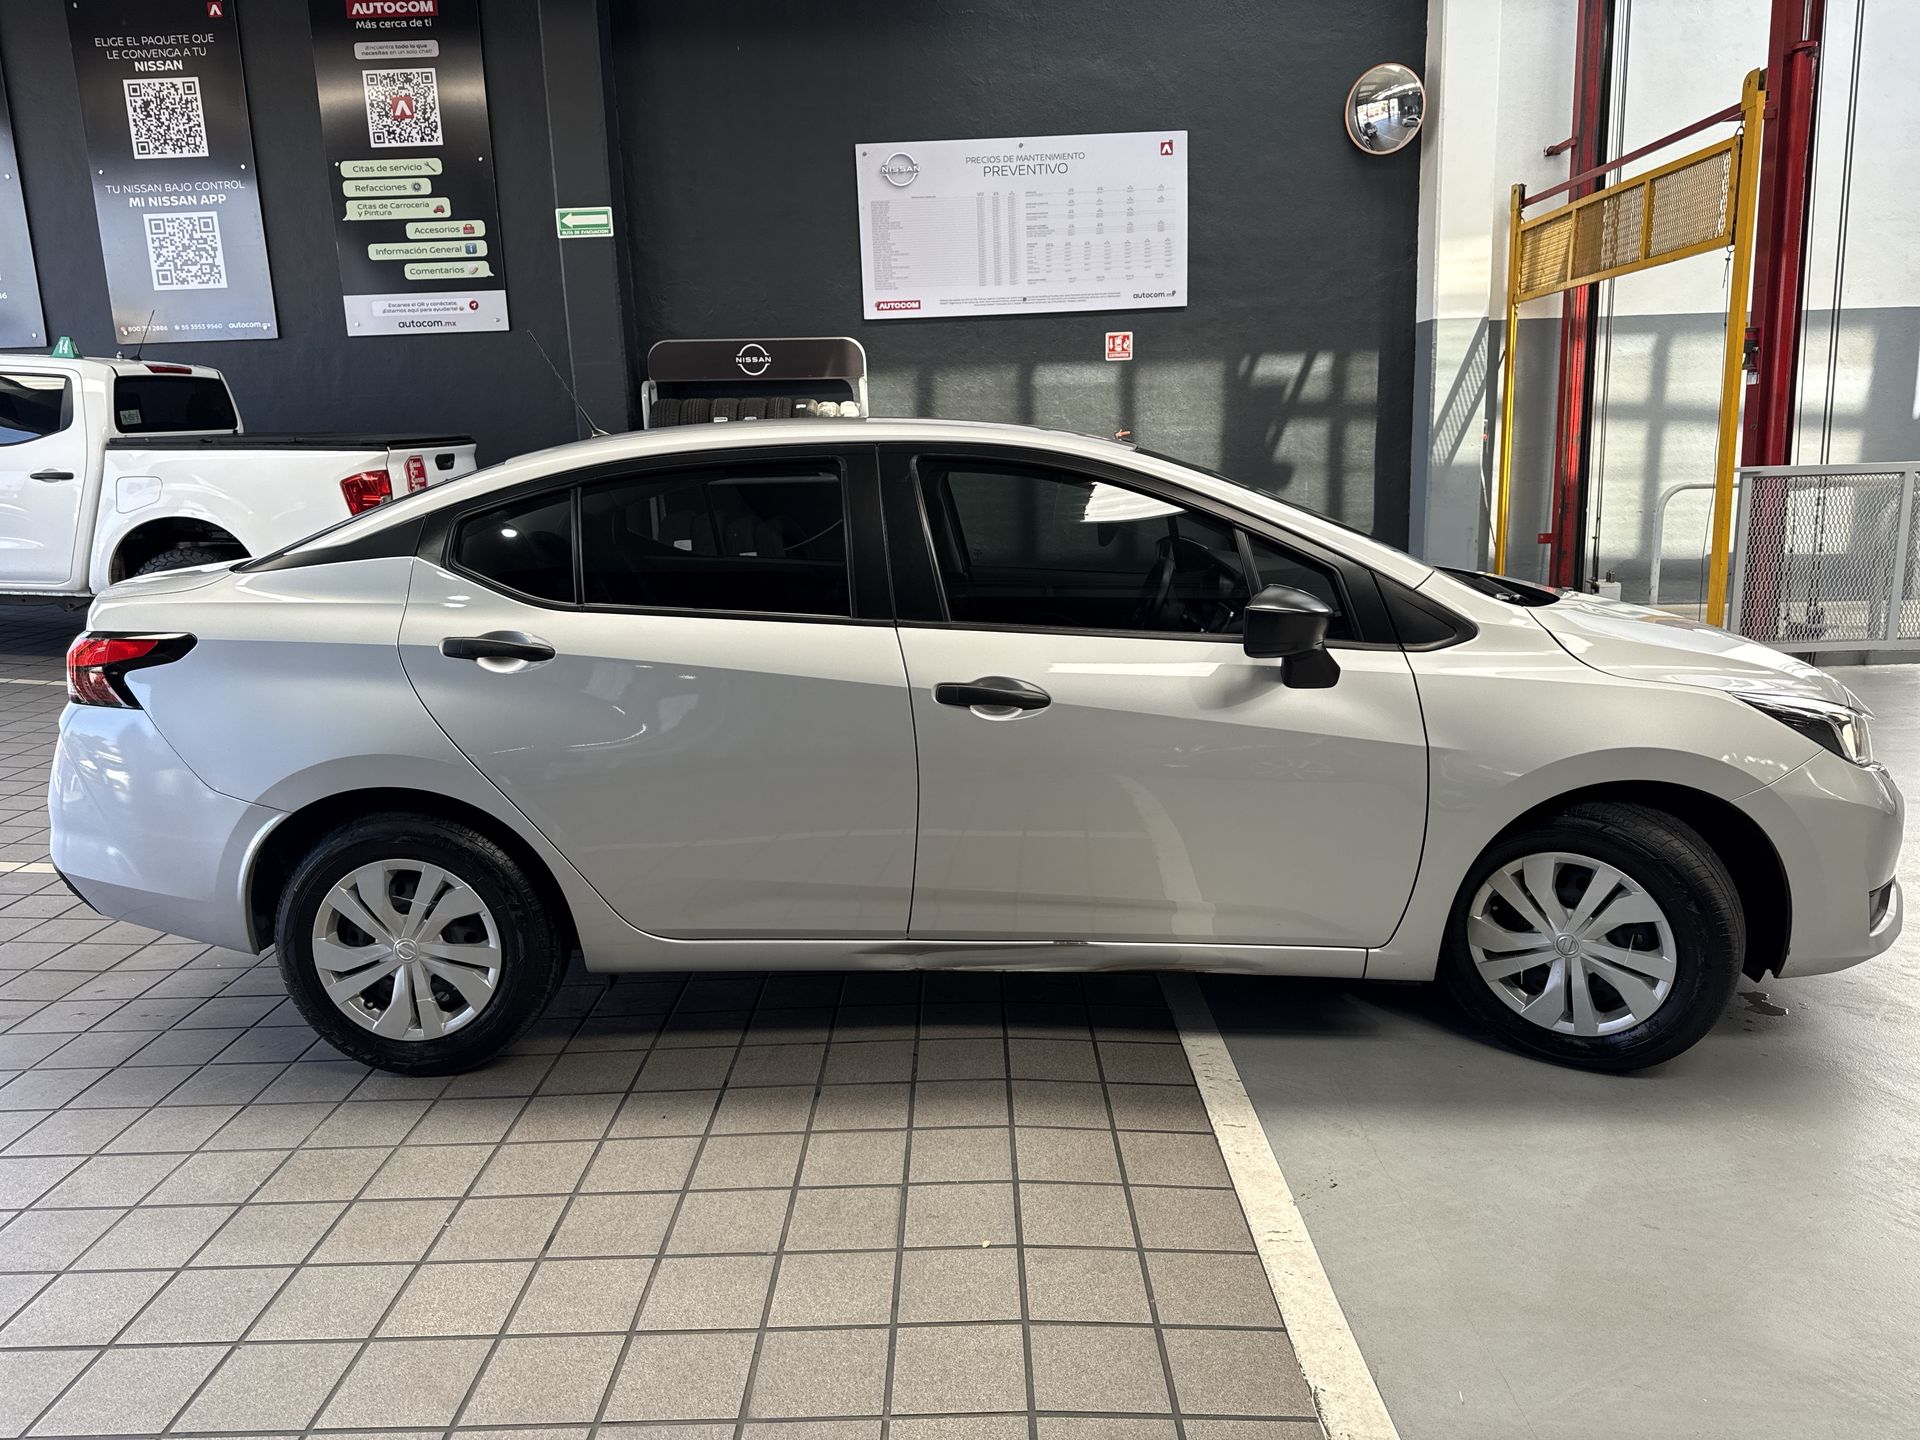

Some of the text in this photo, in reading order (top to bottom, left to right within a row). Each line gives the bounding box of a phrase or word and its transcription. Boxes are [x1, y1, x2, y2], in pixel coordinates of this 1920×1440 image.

[352, 1, 434, 15] AUTOCOM
[356, 20, 377, 29] Más
[409, 19, 422, 27] de
[425, 18, 432, 26] ti
[94, 33, 214, 47] ELIGE EL PAQUETE QUE
[106, 47, 206, 59] LE CONVENGA A TU
[134, 60, 183, 72] NISSAN
[966, 156, 1001, 164] PRECIOS
[1016, 152, 1086, 162] MANTENIMIENTO
[983, 163, 1068, 177] PREVENTIVO
[105, 180, 245, 194] TU NISSAN BAJO CONTROL
[129, 194, 226, 208] MI NISSAN APP
[376, 247, 427, 255] Información
[410, 267, 464, 275] Comentarios
[398, 320, 456, 328] autocom.mx
[59, 340, 69, 354] 14
